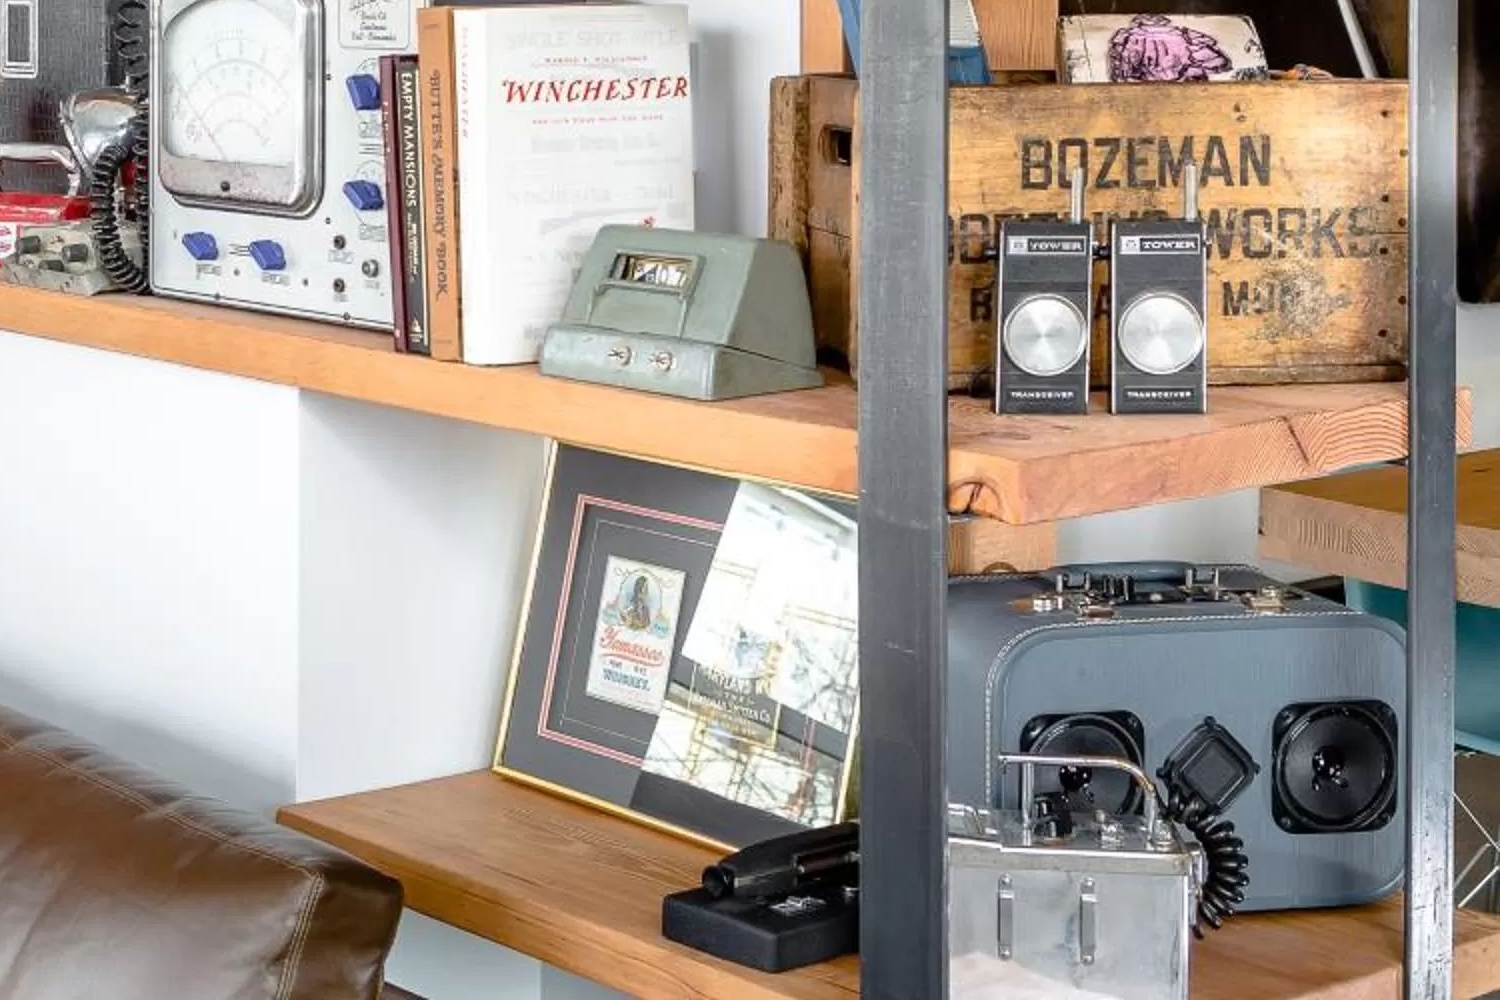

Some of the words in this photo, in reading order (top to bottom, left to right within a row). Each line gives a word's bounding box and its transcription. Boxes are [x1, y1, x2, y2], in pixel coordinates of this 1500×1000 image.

[401, 72, 414, 121] EMPTY
[501, 75, 689, 104] WINCHESTER
[403, 125, 417, 207] MANSIONS
[1020, 134, 1271, 190] BOZEMAN
[431, 152, 446, 238] MEMORY
[1030, 241, 1083, 251] TOWER
[1142, 240, 1196, 250] TOWER
[1198, 207, 1380, 259] WORKS
[434, 241, 449, 301] BOOK
[1010, 390, 1075, 399] TRANSCEIVER
[1127, 390, 1192, 399] TRANSCEIVER
